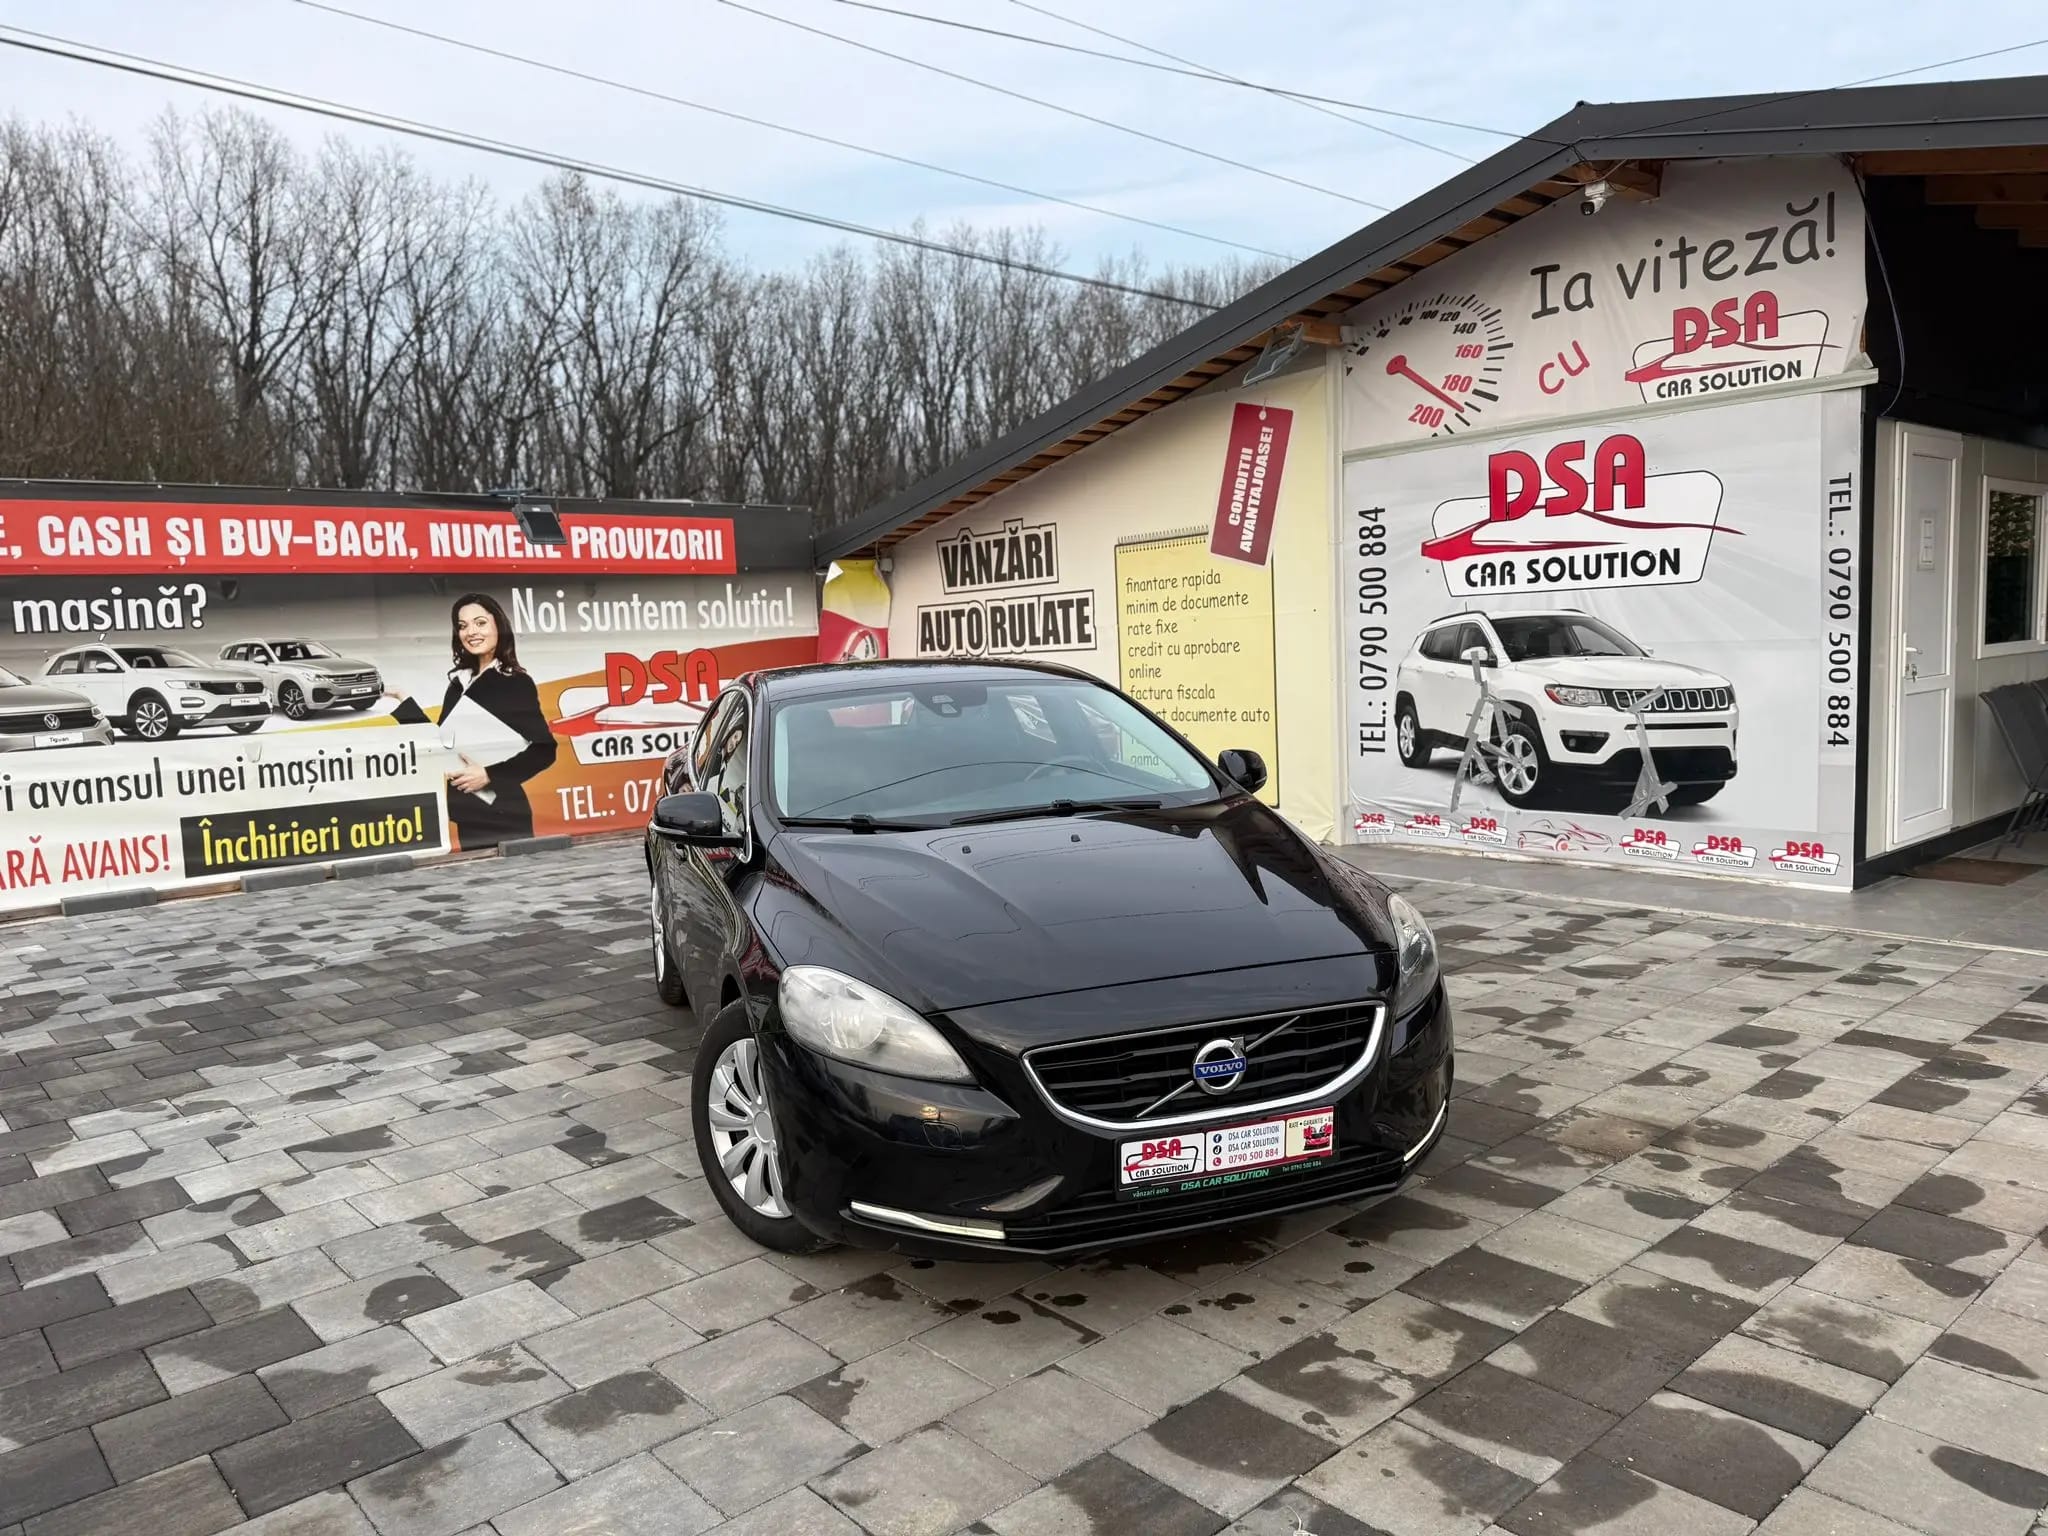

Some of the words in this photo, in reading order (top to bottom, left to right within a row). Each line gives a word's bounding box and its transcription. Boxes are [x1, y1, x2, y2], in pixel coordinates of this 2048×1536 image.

[1531, 264, 1594, 320] Ia
[1616, 191, 1836, 300] viteză!
[1439, 311, 1461, 322] 120
[1673, 290, 1779, 354] DSA
[1453, 322, 1477, 335] 140
[1455, 344, 1484, 359] 160
[1537, 340, 1591, 396] cu
[1656, 375, 1697, 398] CAR
[1699, 360, 1802, 394] SOLUTION
[1441, 374, 1473, 393] 180
[1408, 404, 1445, 428] 200
[1488, 433, 1646, 521] DSA
[1239, 426, 1274, 554] AVANTAJOASE!
[37, 515, 151, 556] CASH
[166, 517, 206, 565] ȘI
[220, 519, 419, 560] BUY-BACK,
[570, 526, 723, 560] PROVIZORII
[1358, 506, 1387, 557] 884
[941, 526, 1056, 588] VÂNZĂRI
[1465, 559, 1516, 588] CAR
[1527, 548, 1681, 584] SOLUTION
[1125, 574, 1178, 594] finantare
[1181, 570, 1221, 592] rapida
[1359, 566, 1388, 615] 500
[1828, 548, 1852, 620] 0790
[14, 583, 207, 641] mașină?
[512, 587, 567, 633] Noi
[577, 593, 687, 631] suntem
[1126, 598, 1159, 615] minim
[1162, 596, 1177, 612] de
[1181, 591, 1249, 610] documente
[919, 605, 985, 652] AUTO
[990, 597, 1092, 648] RULATE
[1127, 621, 1152, 636] rate
[1156, 619, 1178, 635] fixe
[1128, 641, 1163, 657] credit
[1167, 644, 1180, 656] cu
[1184, 638, 1241, 660] aprobare
[1359, 626, 1388, 691] 0790
[1828, 632, 1852, 684] 500
[605, 648, 720, 706] DSA
[1129, 663, 1162, 679] online
[1129, 685, 1173, 700] factura
[1177, 683, 1216, 700] fiscala
[1171, 706, 1237, 722] documente
[1241, 709, 1270, 722] auto
[1827, 695, 1850, 747] 884
[591, 735, 634, 757] CAR
[28, 757, 163, 809] avansul
[177, 756, 245, 796] unei
[258, 747, 353, 793] mașini
[365, 741, 418, 778] noi!
[1361, 813, 1386, 824] DSA
[1414, 814, 1441, 826] DSA
[1470, 817, 1497, 831] DSA
[199, 816, 340, 866] Închirieri
[350, 806, 424, 849] auto!
[1633, 828, 1667, 845] DSA
[1707, 835, 1742, 852] DSA
[62, 834, 171, 883] AVANS!
[1641, 849, 1673, 860] SOLUTION
[1786, 840, 1824, 859] DSA
[1716, 857, 1749, 866] SOLUTION
[1795, 864, 1831, 873] SOLUTION
[1198, 1061, 1243, 1075] VOLVO
[1228, 1143, 1240, 1153] DSA
[1240, 1140, 1251, 1150] CAR
[1252, 1136, 1280, 1148] SOLUTION
[1229, 1132, 1240, 1141] DSA
[1240, 1130, 1251, 1139] CAR
[1252, 1125, 1280, 1137] SOLUTION
[1142, 1138, 1182, 1161] DSA
[1228, 1153, 1248, 1164] 0790
[1249, 1151, 1263, 1160] 500
[1265, 1148, 1279, 1157] 884
[1135, 1170, 1150, 1178] CAR
[1152, 1164, 1190, 1176] SOLUTION
[1181, 1181, 1201, 1191] DSA
[1202, 1176, 1222, 1187] CAR
[1223, 1168, 1270, 1185] SOLUTION
[1156, 1187, 1169, 1195] auto
